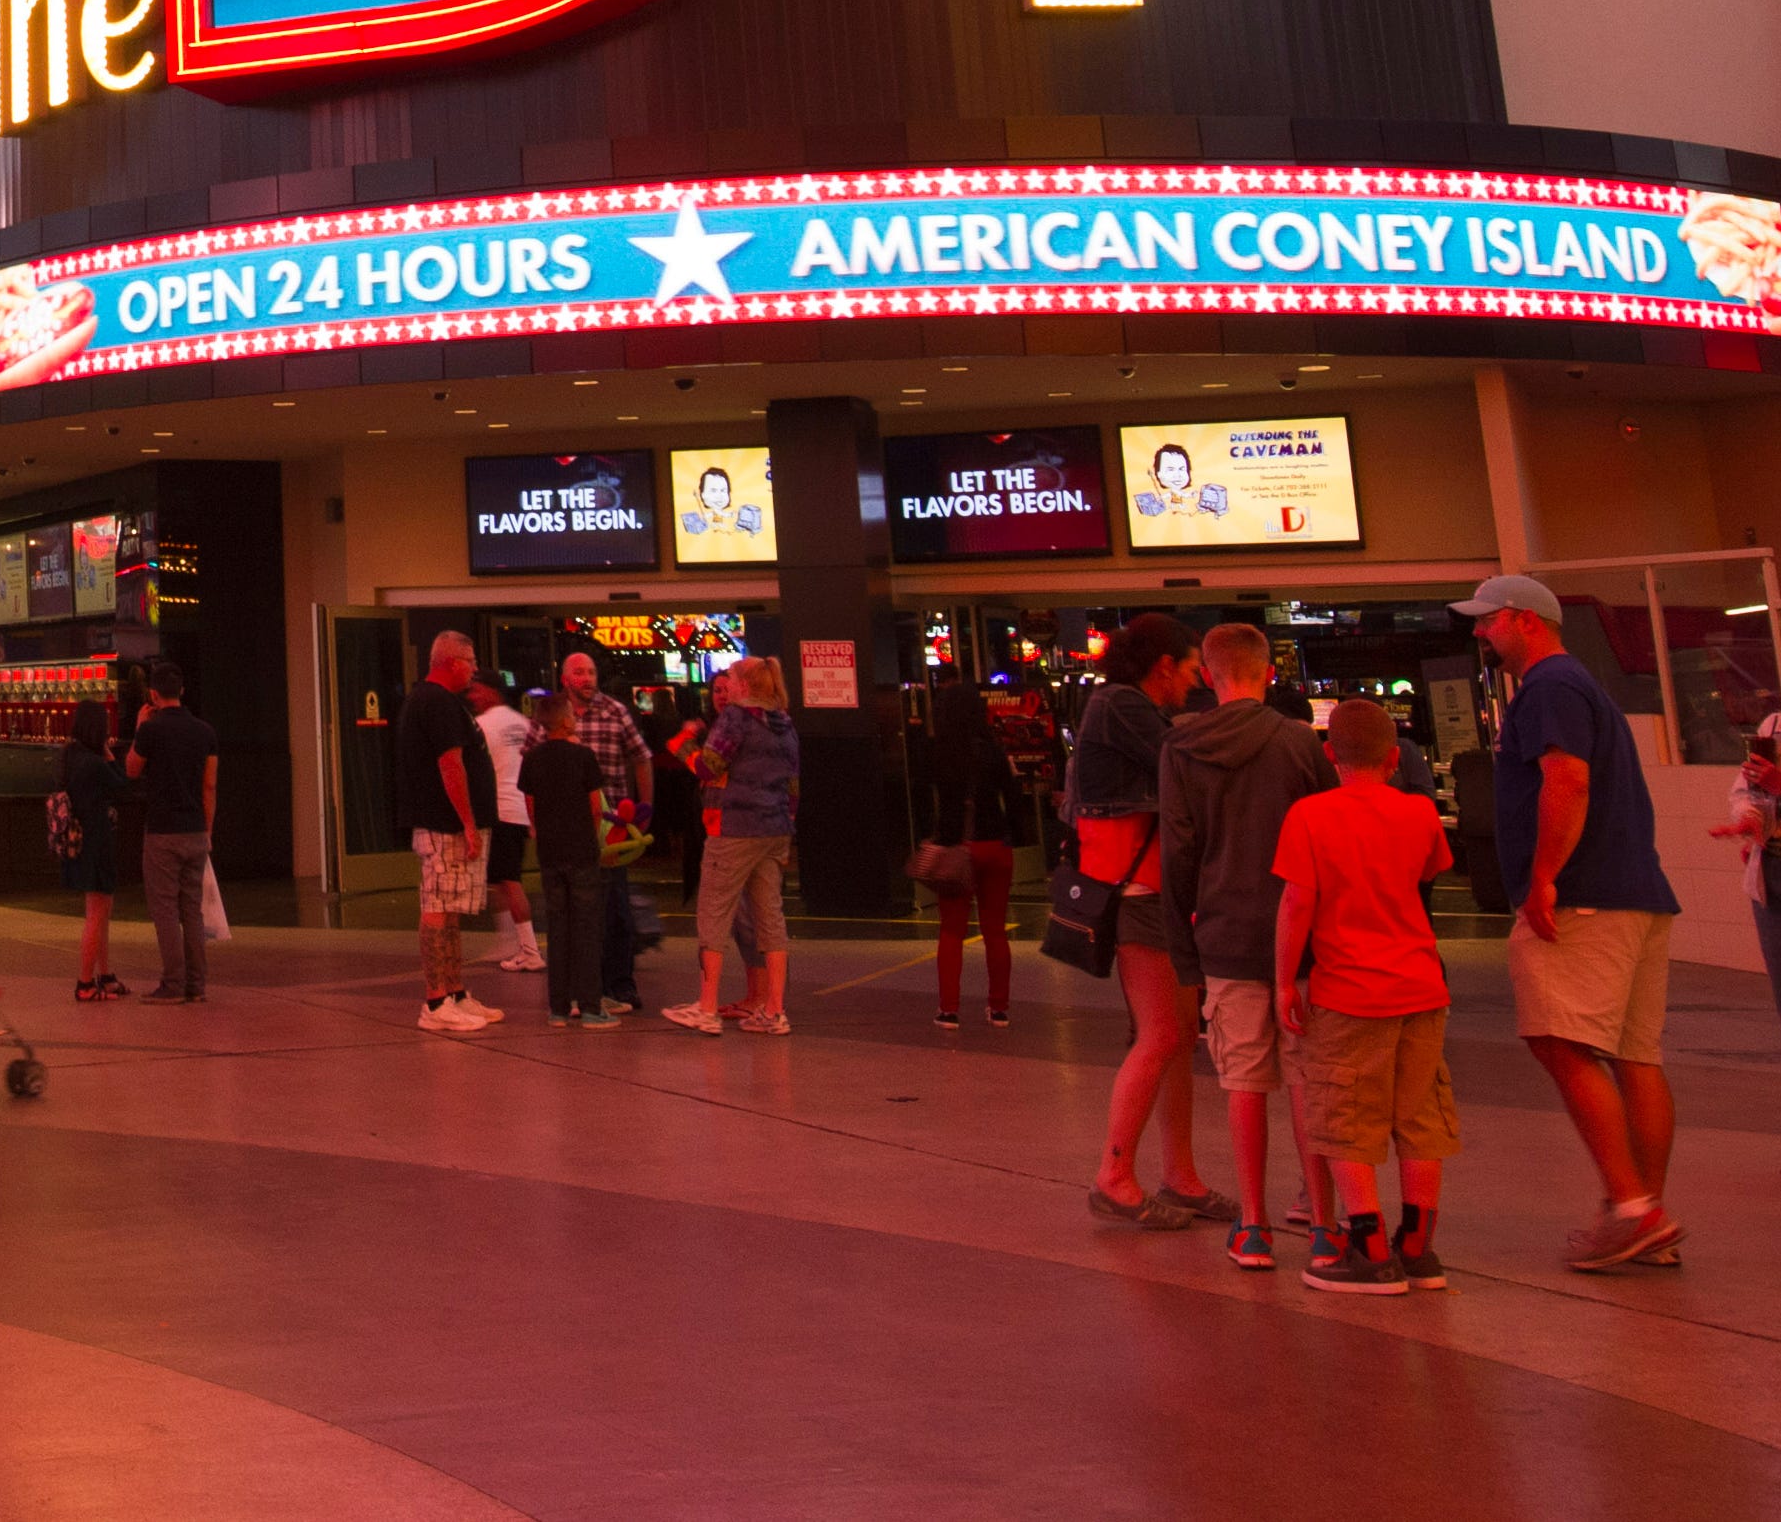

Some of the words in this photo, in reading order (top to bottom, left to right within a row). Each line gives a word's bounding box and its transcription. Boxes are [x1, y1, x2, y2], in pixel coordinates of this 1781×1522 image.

[789, 210, 1198, 279] AMERICAN
[1211, 210, 1455, 276] CONEY
[1465, 215, 1670, 287] ISLAND
[116, 263, 257, 336] OPEN
[266, 258, 345, 319] 24
[356, 231, 593, 310] HOURS
[1229, 429, 1294, 443] DEFENDING
[1296, 429, 1320, 440] THE
[1228, 440, 1325, 459] CAVEMAN
[949, 470, 988, 493] LET
[991, 467, 1037, 492] THE
[521, 490, 554, 511] LET
[558, 488, 597, 510] THE
[901, 492, 1004, 519] FLAVORS
[1008, 489, 1093, 515] BEGIN.
[477, 512, 567, 535] FLAVORS
[571, 508, 644, 532] BEGIN.
[592, 626, 655, 647] SLOTS
[802, 643, 853, 655] RESERVED
[804, 654, 852, 667] PARKING
